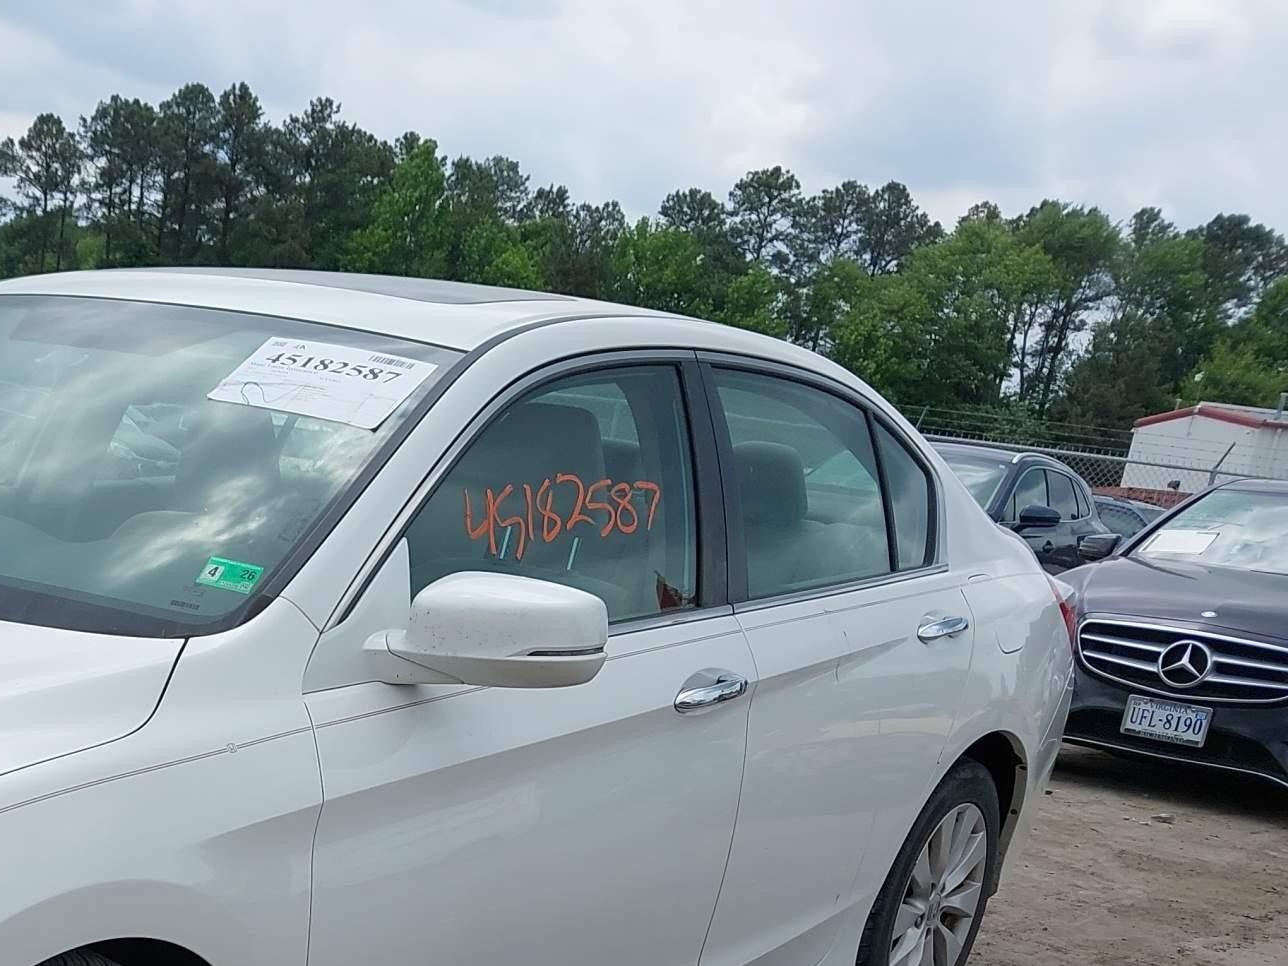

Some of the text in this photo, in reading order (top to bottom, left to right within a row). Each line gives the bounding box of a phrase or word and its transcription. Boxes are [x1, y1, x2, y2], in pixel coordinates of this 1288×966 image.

[265, 352, 403, 384] 45182587
[464, 472, 661, 561] 45182587
[208, 566, 257, 581] 4 26
[1130, 707, 1203, 736] UFL-8190
[1149, 702, 1189, 715] VIRGINIA
